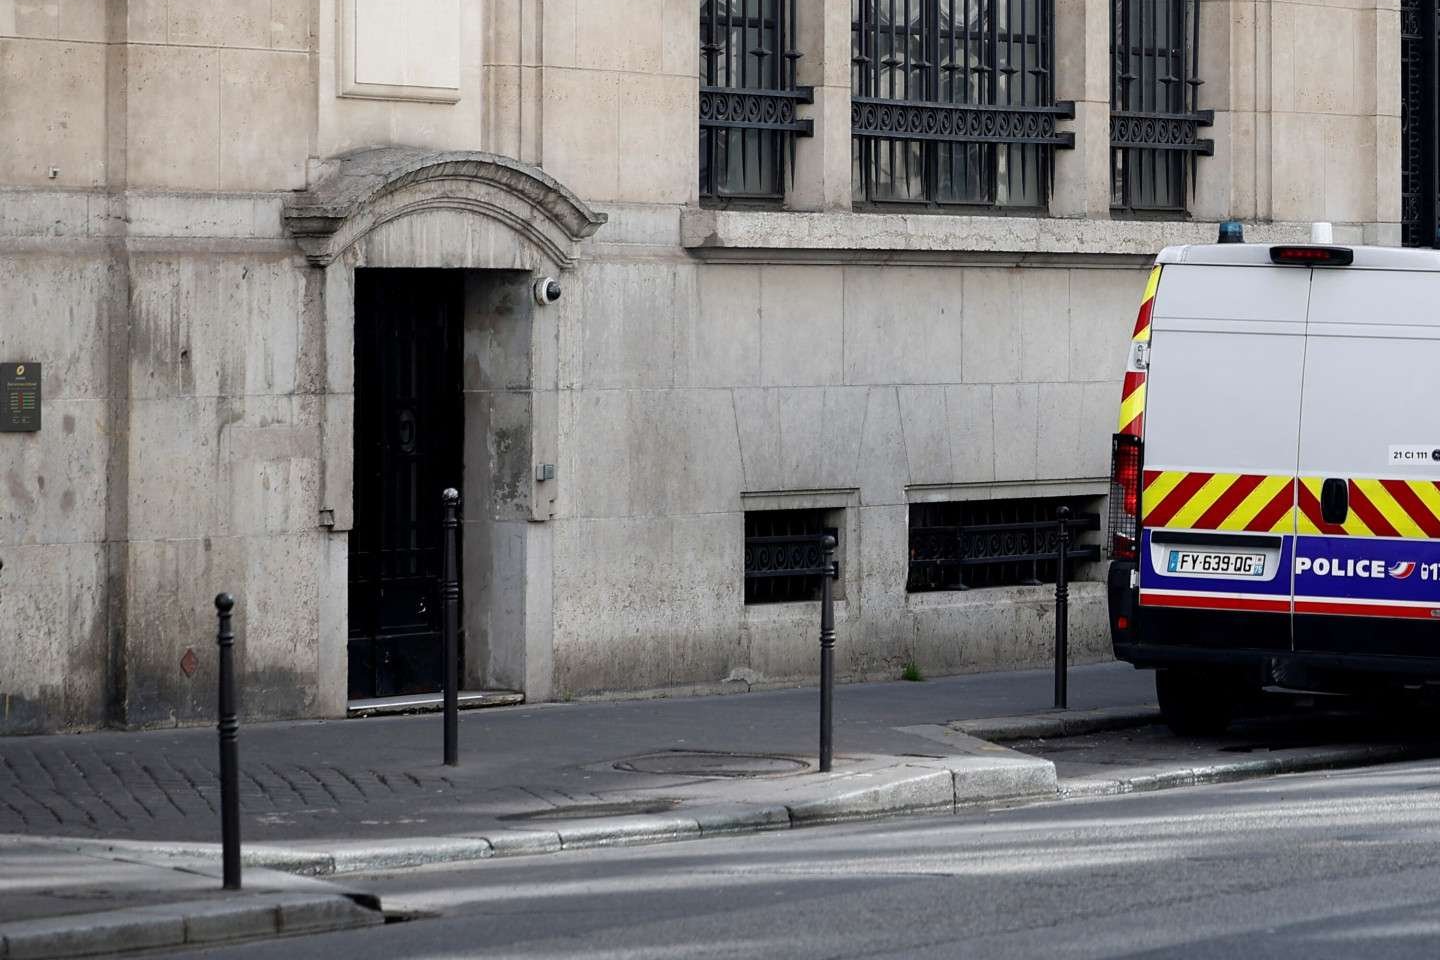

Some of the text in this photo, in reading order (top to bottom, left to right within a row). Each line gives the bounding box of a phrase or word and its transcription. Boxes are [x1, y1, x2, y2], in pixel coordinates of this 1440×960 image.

[1393, 451, 1402, 459] 21
[1404, 451, 1414, 459] CI
[1295, 557, 1386, 578] POLICE
